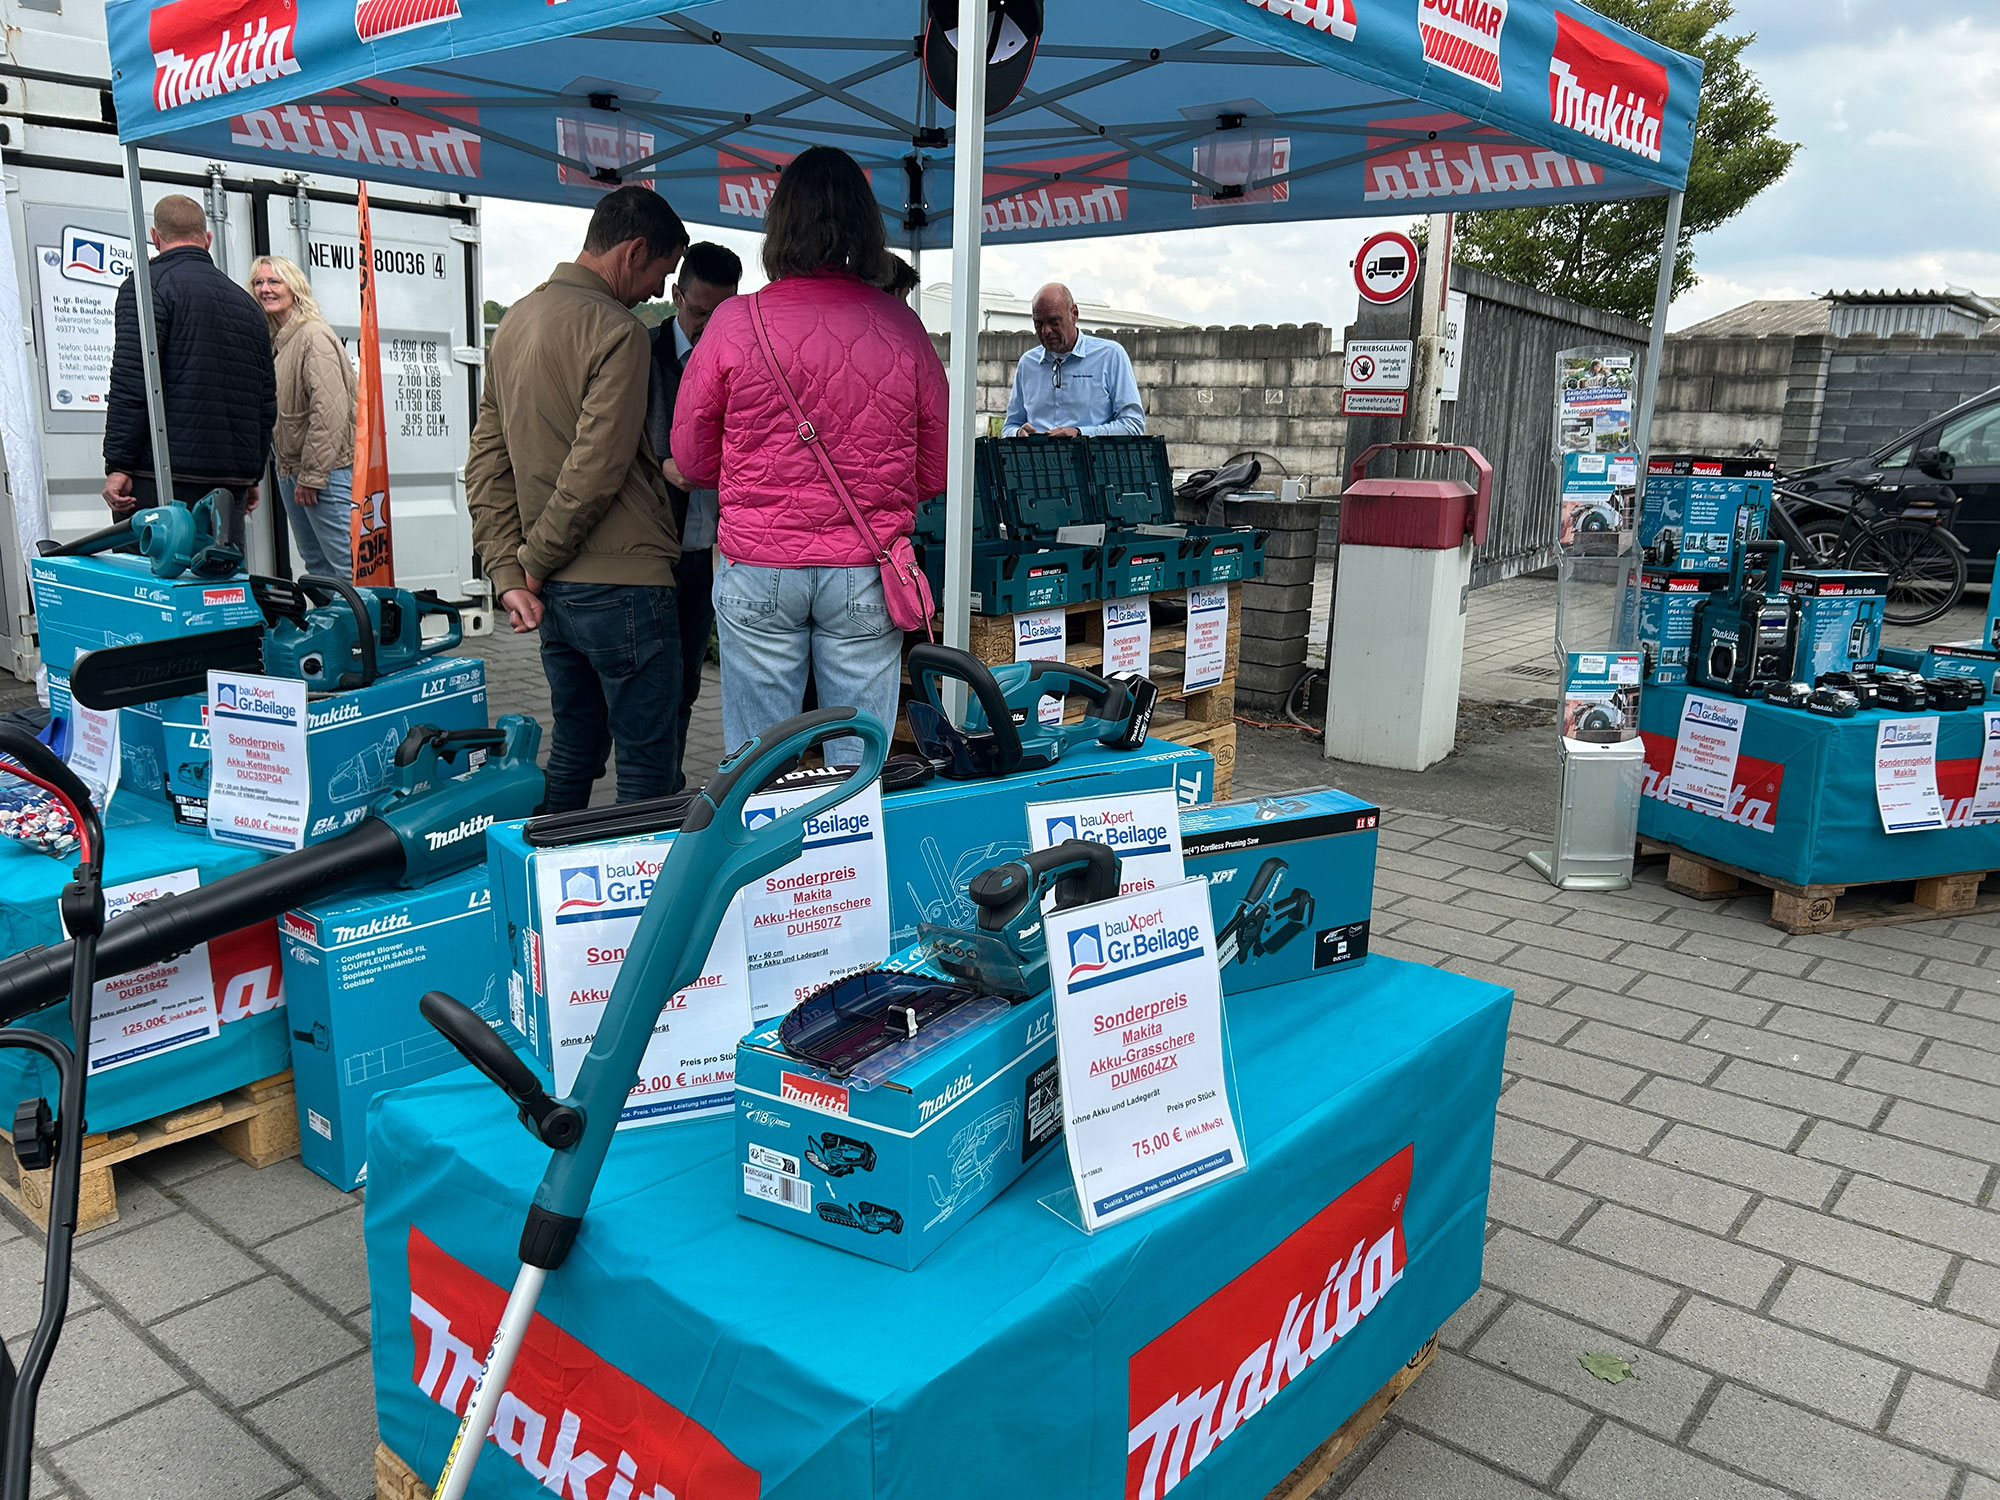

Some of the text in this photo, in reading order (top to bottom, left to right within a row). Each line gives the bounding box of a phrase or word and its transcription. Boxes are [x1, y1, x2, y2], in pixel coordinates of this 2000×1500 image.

[309, 243, 354, 270] NEWU
[436, 255, 444, 277] 4
[53, 295, 102, 306] H. Beilage
[54, 305, 78, 314] Holz &
[93, 317, 113, 325] Straße
[78, 326, 99, 334] Vechta
[57, 342, 82, 351] Telefon:
[393, 339, 437, 351] 6.000 KGS
[1352, 344, 1407, 352] BETRIEBSGELÄNDE
[58, 353, 82, 361] Telefax:
[389, 351, 437, 363] 13.230 LBS
[1450, 351, 1455, 368] 2
[59, 363, 82, 371] E-Mail:
[404, 364, 441, 376] 950 KGS
[398, 375, 441, 387] 2.100 LBS
[399, 388, 441, 400] 5.050 KGS
[395, 400, 441, 412] 11.130 LBS
[405, 414, 446, 425] 9.95 CU.M
[401, 425, 449, 436] 351.2 CU.FT
[134, 586, 148, 598] LXT
[1119, 610, 1146, 621] Gr.Beilage
[1032, 624, 1062, 637] Gr.Beilage
[1113, 635, 1141, 647] Sonderpreis
[239, 685, 275, 699] bauXpert
[421, 678, 446, 700] LXT
[239, 698, 296, 719] Gr.Beilage
[1702, 710, 1738, 727] Gr.Beilage
[228, 734, 285, 751] Sonderpreis
[1690, 732, 1726, 747] Sonderpreis
[1897, 731, 1932, 742] Gr.Beilage
[246, 750, 270, 761] Makita
[1878, 756, 1932, 768] Sonderangebot
[227, 757, 290, 774] Akku-Kettensäge
[1894, 769, 1917, 777] Makita
[237, 769, 282, 784] DUC353PG4
[263, 820, 268, 829] €
[341, 806, 368, 828] XPT
[806, 813, 870, 836] Beilage
[1080, 810, 1134, 828] bauXpert
[1082, 825, 1167, 847] Gr.Beilage
[1200, 837, 1260, 852] Cordless Pruning Saw
[607, 860, 663, 879] bauXpe
[1209, 867, 1238, 885] XPT
[766, 866, 856, 892] Sonderpreis
[108, 888, 158, 908] bauXpert
[793, 888, 832, 904] Makita
[753, 897, 871, 927] Akku-Heckenschere
[332, 913, 412, 944] Makita
[787, 916, 842, 936] DUH507Z
[1105, 909, 1163, 936] bauXpert
[1107, 922, 1199, 964] Gr.Beilage
[341, 943, 404, 964] Cordless Blower
[341, 944, 427, 972] SOUFFLEUR SANS FIL
[763, 951, 771, 959] 50
[763, 948, 829, 968] Akku und Ladegerät
[342, 954, 426, 982] Sopladora Inalámbrica
[829, 965, 858, 976] Preis pro
[105, 965, 179, 992] Akku-Gebläse
[343, 977, 375, 990] Gebläse
[119, 979, 169, 1000] DUB184Z
[1093, 993, 1188, 1033] Sonderpreis
[1026, 1013, 1049, 1045] LXT
[1122, 1023, 1163, 1046] Makita
[560, 1036, 582, 1046] ohne
[680, 1052, 737, 1067] Preis pro Stüc
[1089, 1031, 1195, 1077] Akku-Grasschere
[1111, 1054, 1178, 1088] DUM604ZX
[676, 1072, 687, 1087] €
[781, 1080, 846, 1114] Makita
[918, 1073, 974, 1124] Makita
[1166, 1089, 1217, 1113] Preis pro Stück
[651, 1105, 673, 1115] Unsere
[673, 1101, 699, 1112] Leistung
[1072, 1088, 1161, 1125] ohne Akku und Ladegerät
[1132, 1117, 1224, 1159] 75,00 € inkl.MwSt
[1159, 1177, 1177, 1187] Unsere
[1177, 1168, 1198, 1181] Leistung
[1204, 1156, 1226, 1169] messbar!
